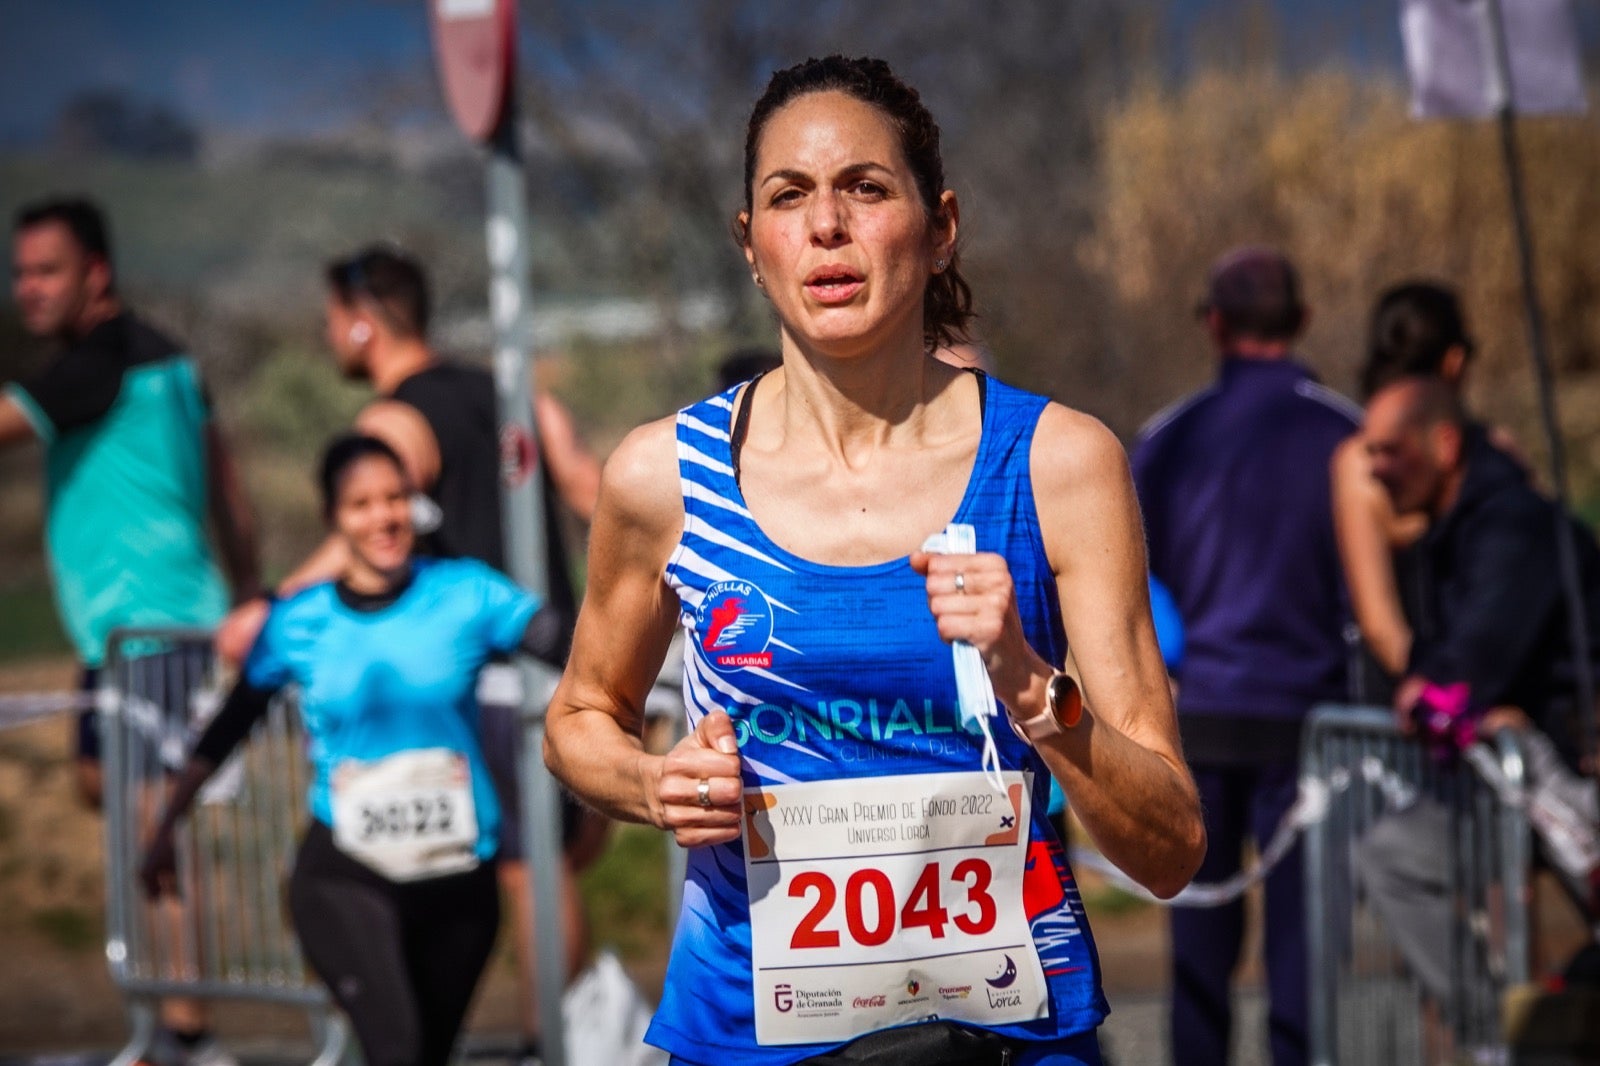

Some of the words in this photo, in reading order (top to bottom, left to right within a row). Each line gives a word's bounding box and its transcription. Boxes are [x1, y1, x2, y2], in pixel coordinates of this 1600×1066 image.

[707, 581, 753, 602] HUELLAS
[721, 656, 736, 665] LAS
[737, 656, 769, 667] GABIAS
[929, 737, 970, 756] DEN
[780, 806, 813, 827] XXXV
[818, 804, 849, 825] GRAN
[853, 801, 897, 822] PREMIO
[921, 797, 957, 818] FONDO
[961, 794, 993, 815] 2022
[847, 824, 897, 844] UNIVERSO
[900, 823, 931, 841] LORCA
[788, 858, 997, 949] 2043
[796, 988, 842, 999] Diputación
[938, 985, 972, 995] Cruzcampo
[796, 1001, 805, 1009] de
[807, 998, 843, 1009] Granada
